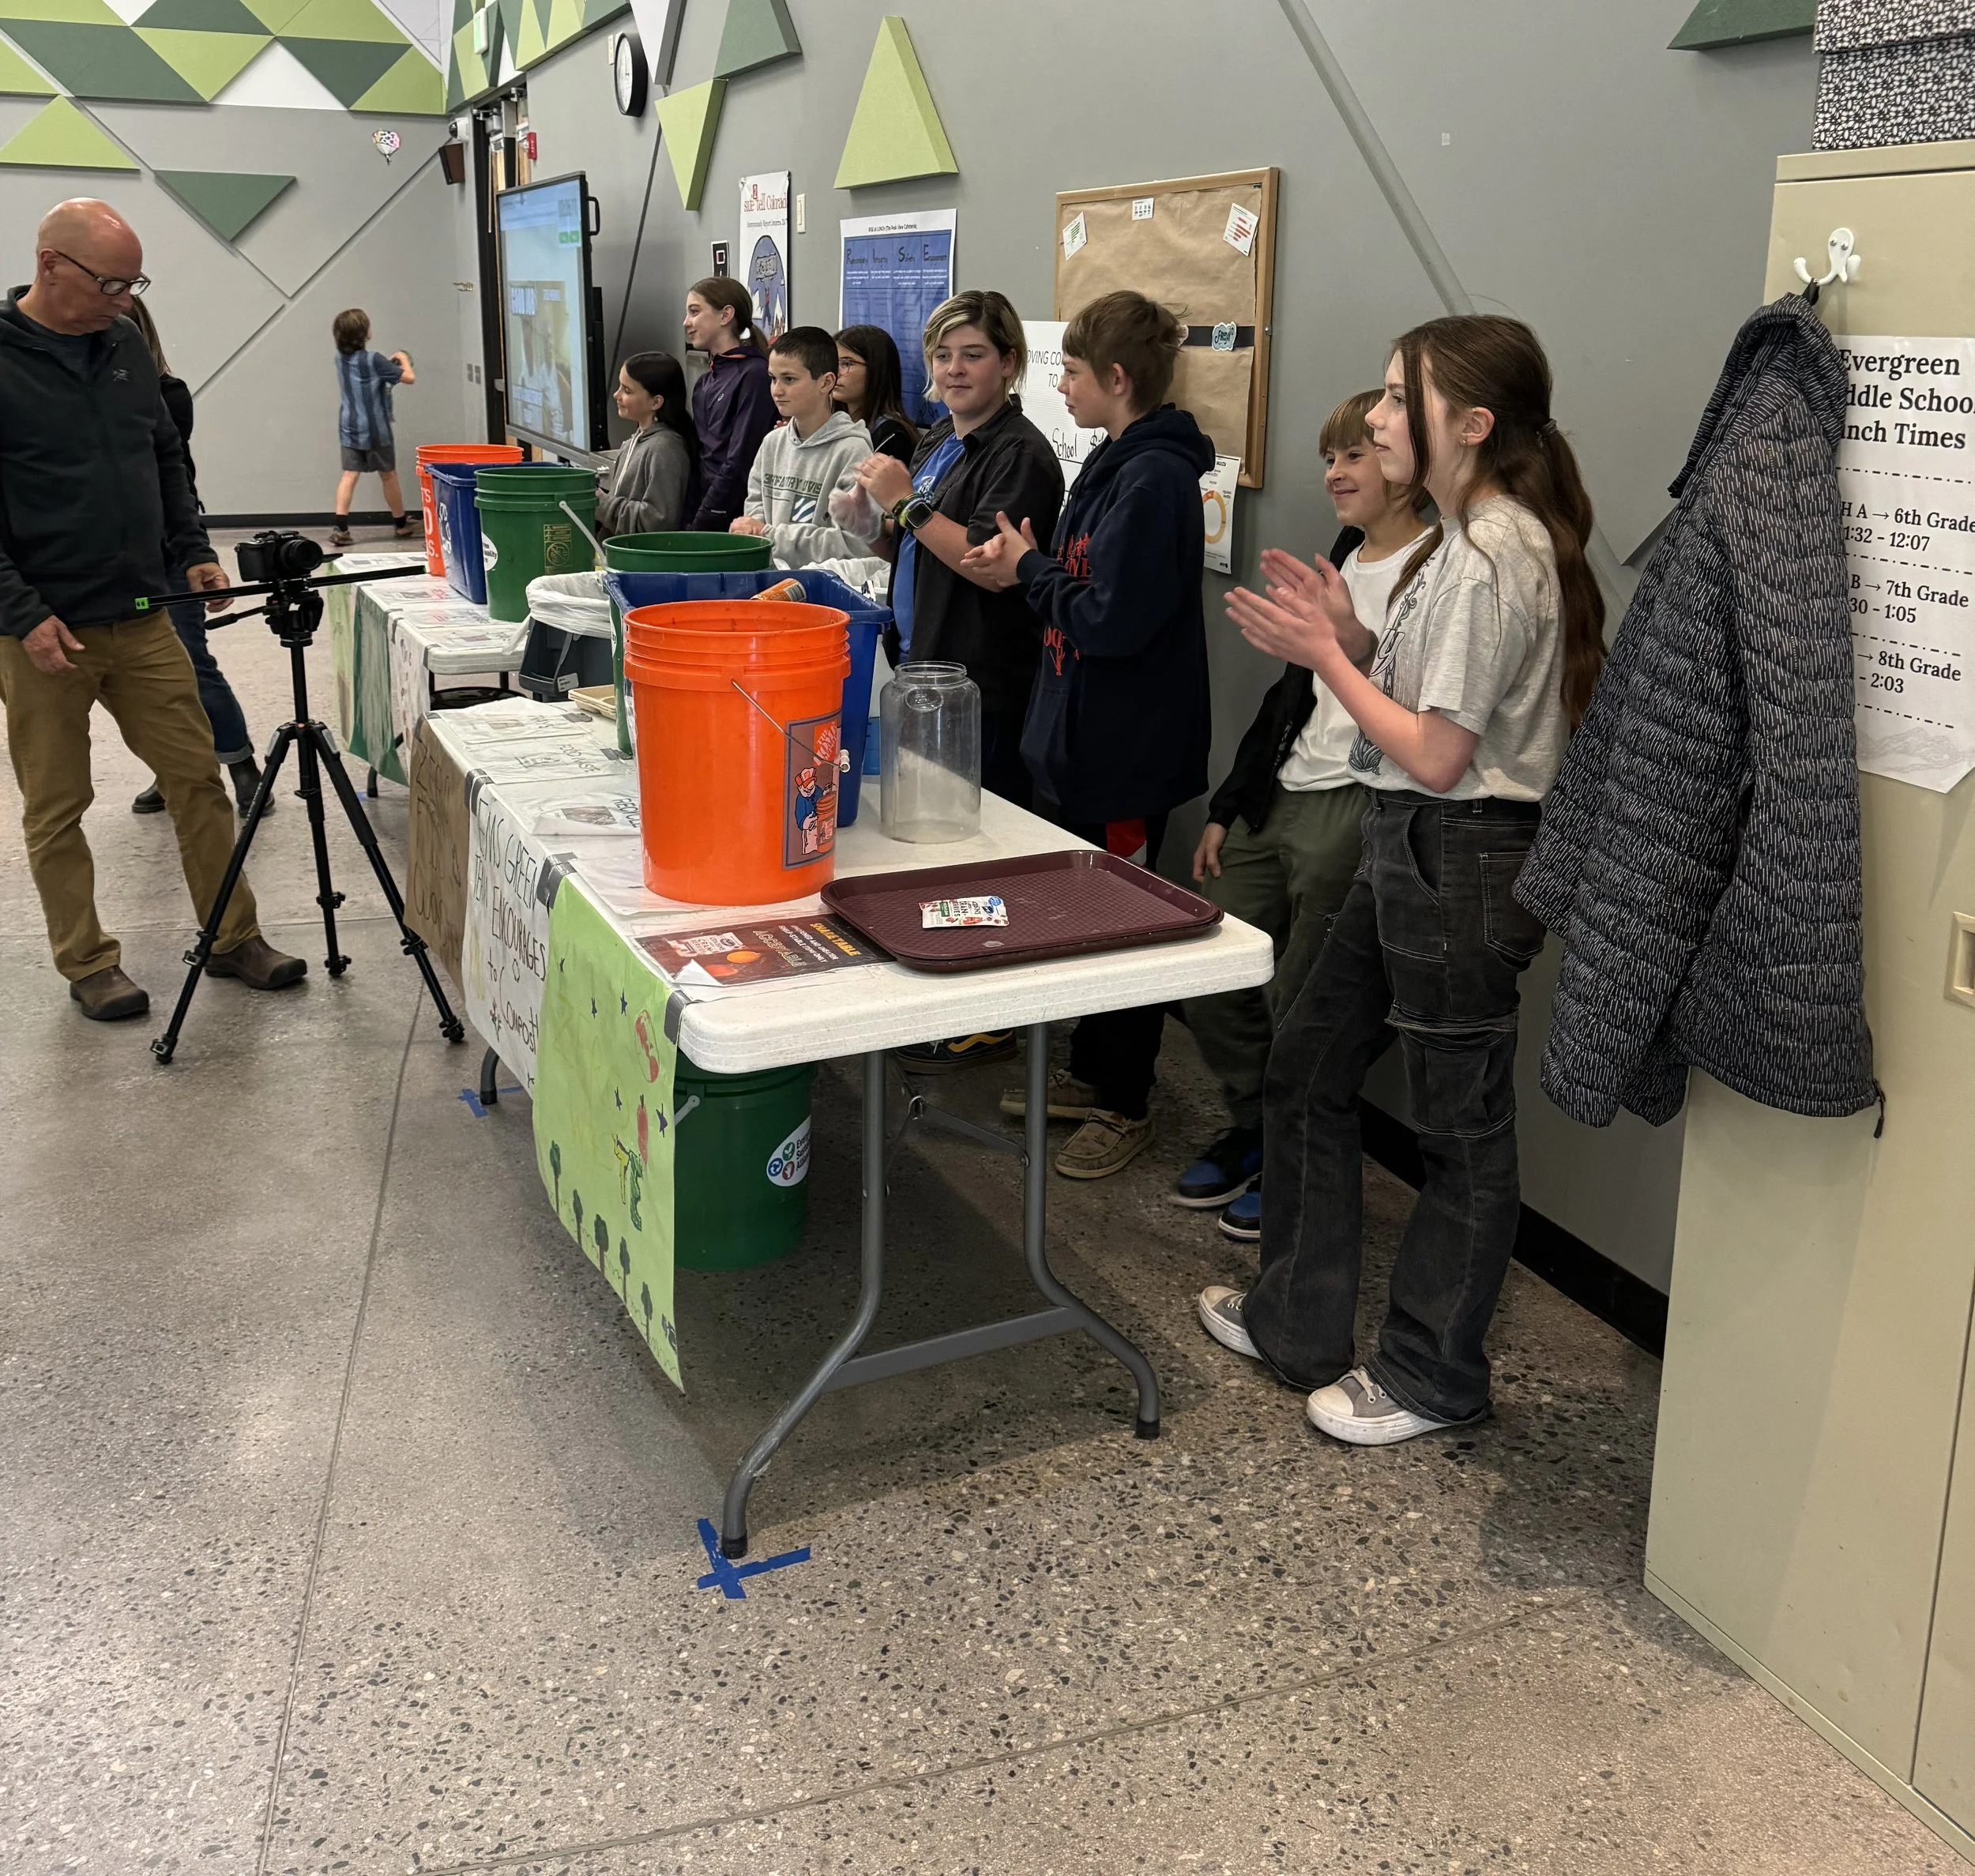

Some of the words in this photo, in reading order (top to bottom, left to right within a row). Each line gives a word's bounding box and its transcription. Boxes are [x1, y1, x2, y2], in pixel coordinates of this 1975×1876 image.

[1839, 349, 1961, 381] Evergreen
[1846, 384, 1893, 408] ddle
[1898, 387, 1975, 414] Schoo
[1052, 427, 1078, 458] School
[1894, 423, 1966, 449] Times
[1856, 503, 1868, 519] A
[1894, 508, 1921, 525] 6th
[1844, 526, 1872, 543] 1:32
[1889, 532, 1930, 551] 12:07
[1850, 574, 1861, 589] B
[1886, 580, 1912, 599] 7th
[1917, 585, 1969, 607] Grade
[1885, 604, 1917, 623] 1:05
[1878, 651, 1905, 670] 8th
[1909, 657, 1962, 681] Grade
[1871, 673, 1905, 693] 2:03
[478, 798, 504, 869] EMS
[504, 834, 538, 912] GREEN
[491, 885, 546, 982] ENCOURAGES
[831, 937, 863, 957] TABLE
